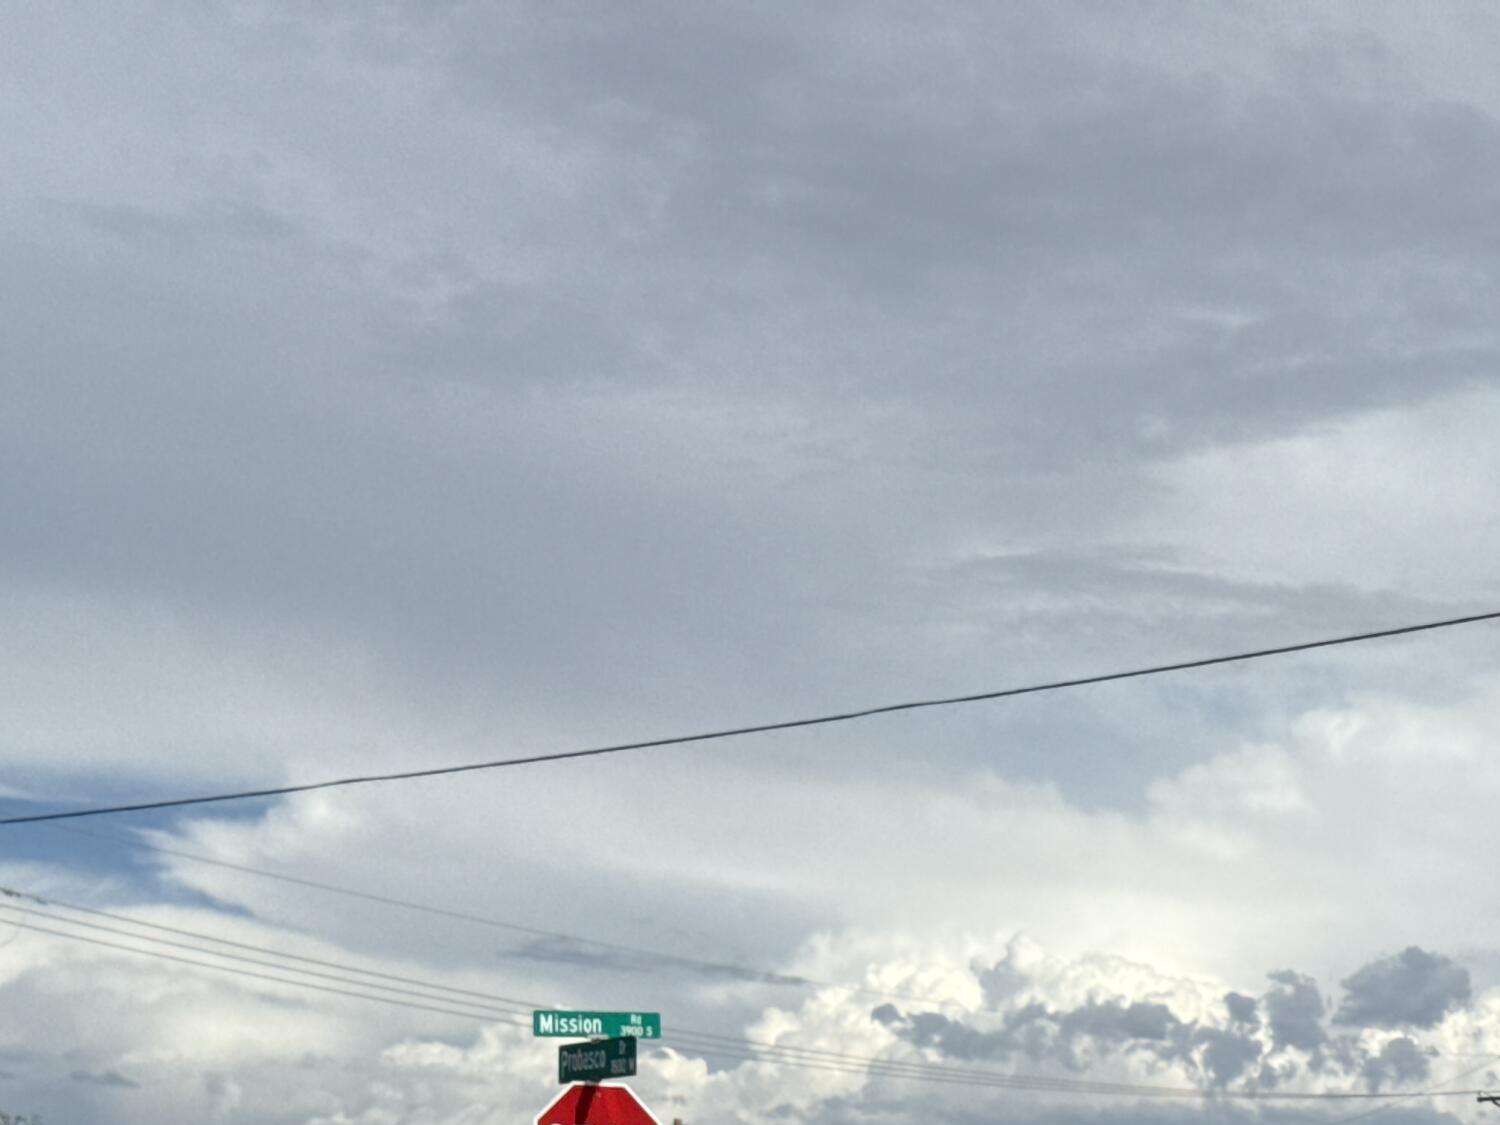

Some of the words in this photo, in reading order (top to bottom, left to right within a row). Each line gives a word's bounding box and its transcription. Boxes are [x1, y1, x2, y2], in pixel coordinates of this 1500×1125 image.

[539, 1013, 602, 1034] Mission
[630, 1014, 642, 1025] Rd
[646, 1026, 653, 1037] S
